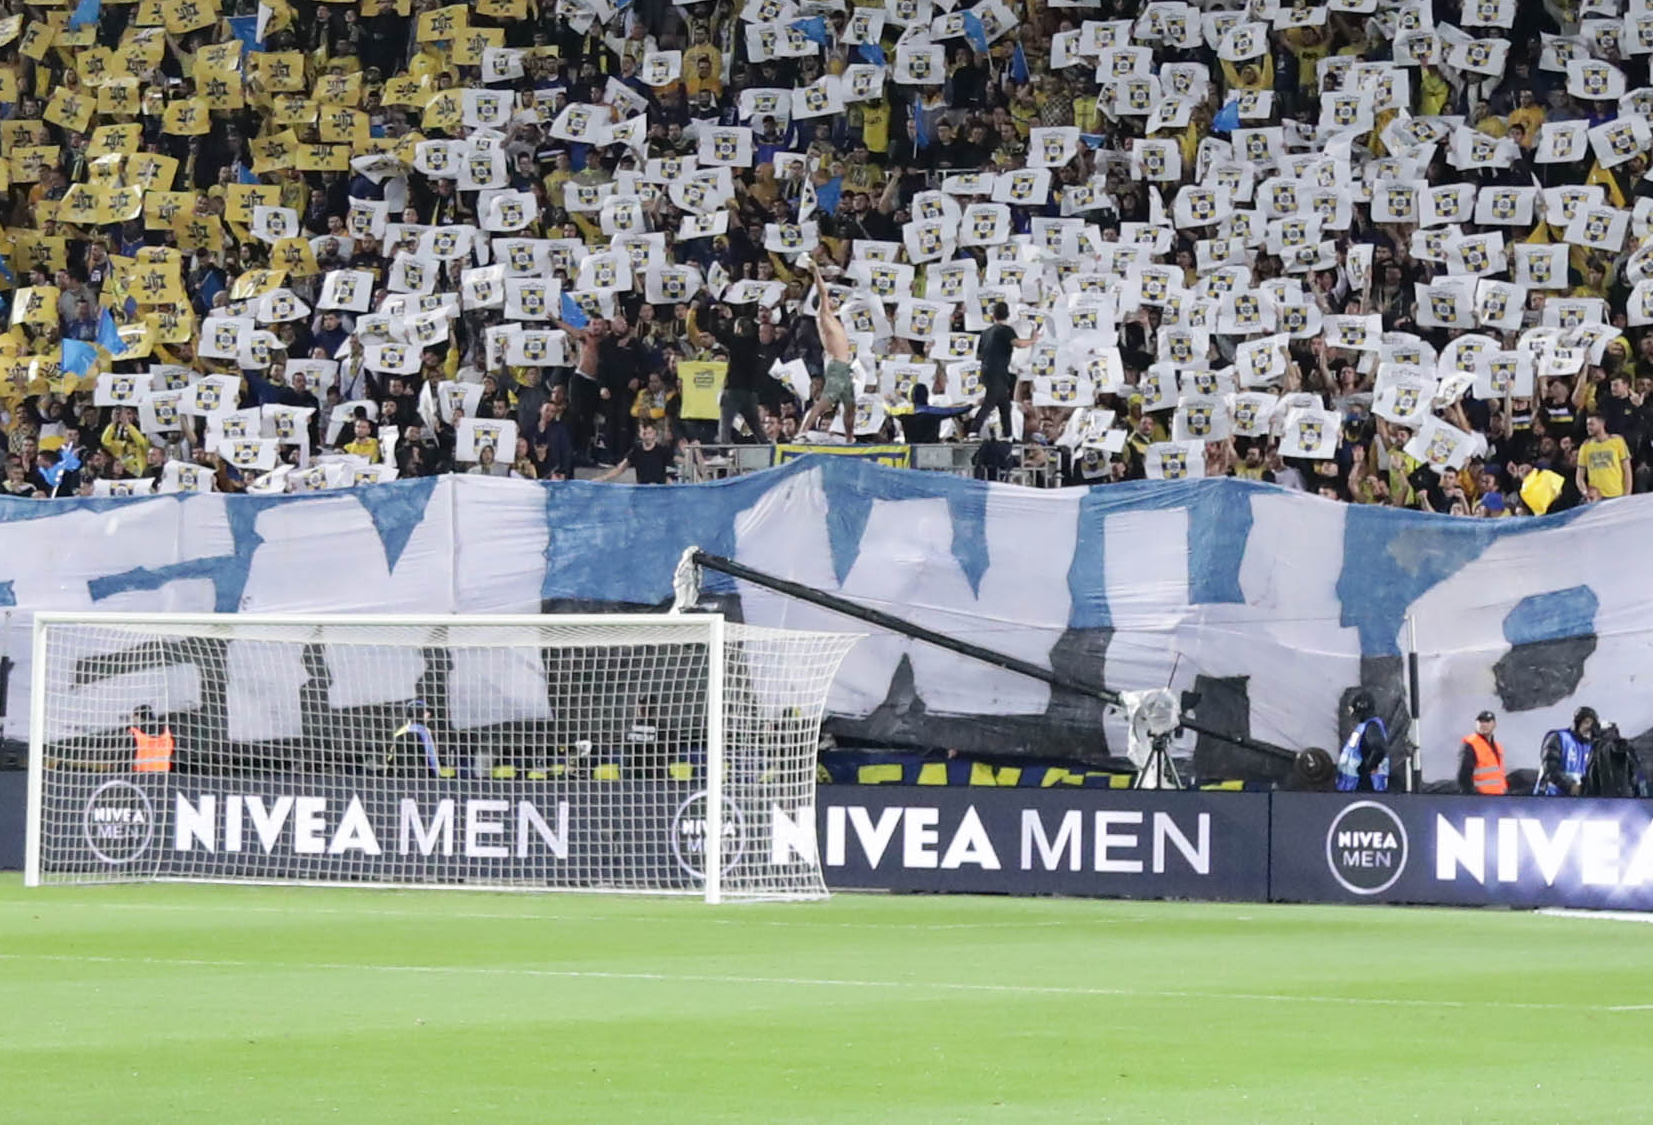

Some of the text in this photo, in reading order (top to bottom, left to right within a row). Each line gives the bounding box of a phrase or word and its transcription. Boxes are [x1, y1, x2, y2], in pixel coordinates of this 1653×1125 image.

[94, 808, 145, 823] NIVEA
[174, 791, 570, 860] NIVEA MEN
[682, 819, 736, 835] NIVA
[772, 803, 1210, 875] NIVEA MEN
[1338, 830, 1398, 851] NIVEA
[1342, 850, 1393, 869] MEN
